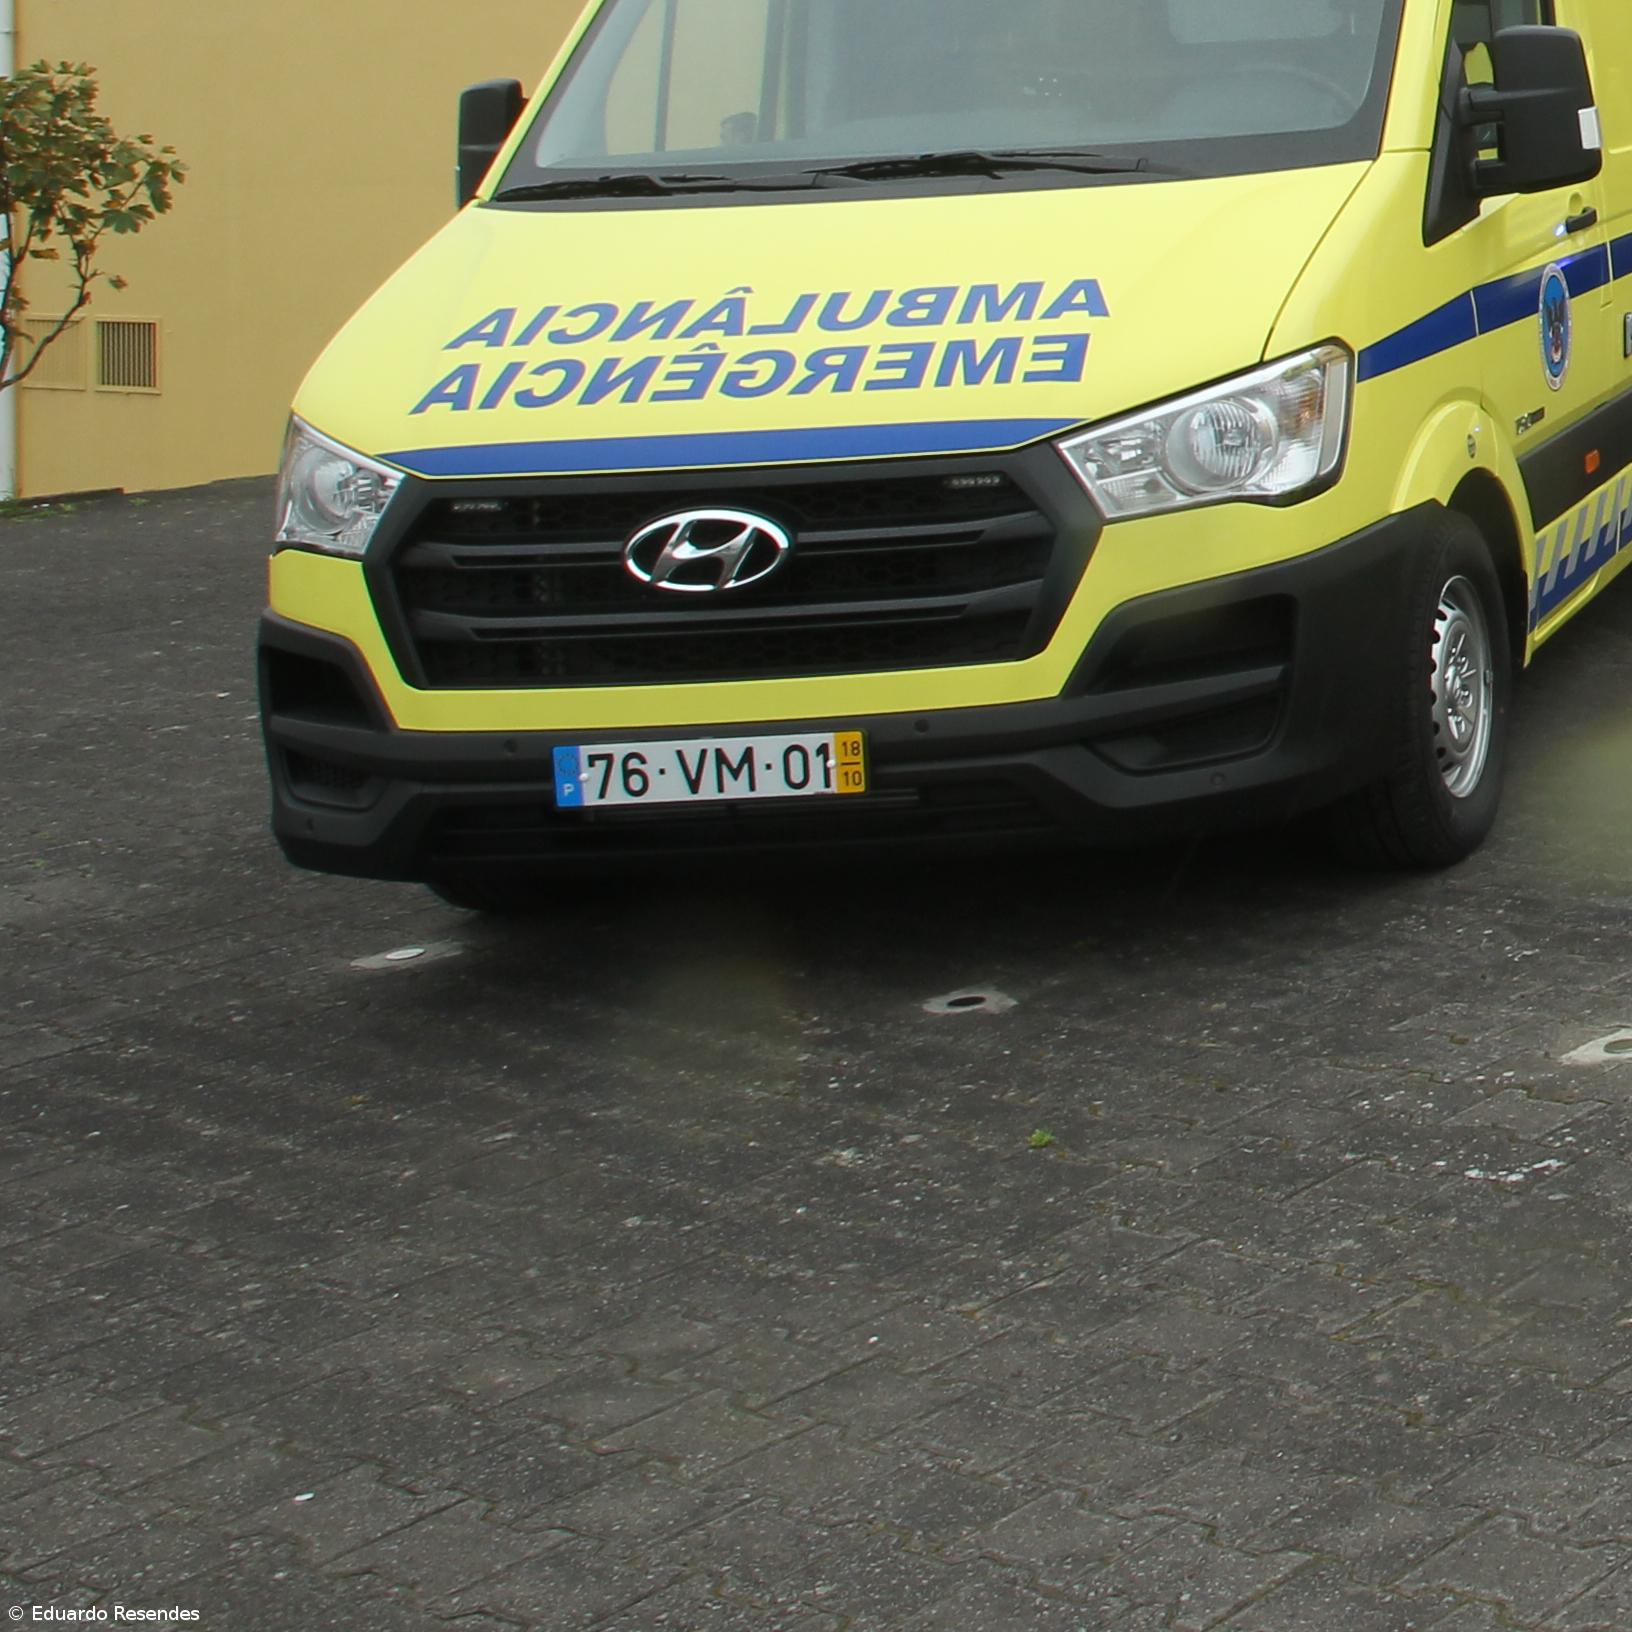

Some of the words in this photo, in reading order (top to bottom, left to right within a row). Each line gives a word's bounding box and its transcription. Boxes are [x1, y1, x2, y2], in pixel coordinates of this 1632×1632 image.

[841, 740, 861, 757] 18
[843, 771, 863, 787] 10
[564, 783, 575, 797] P
